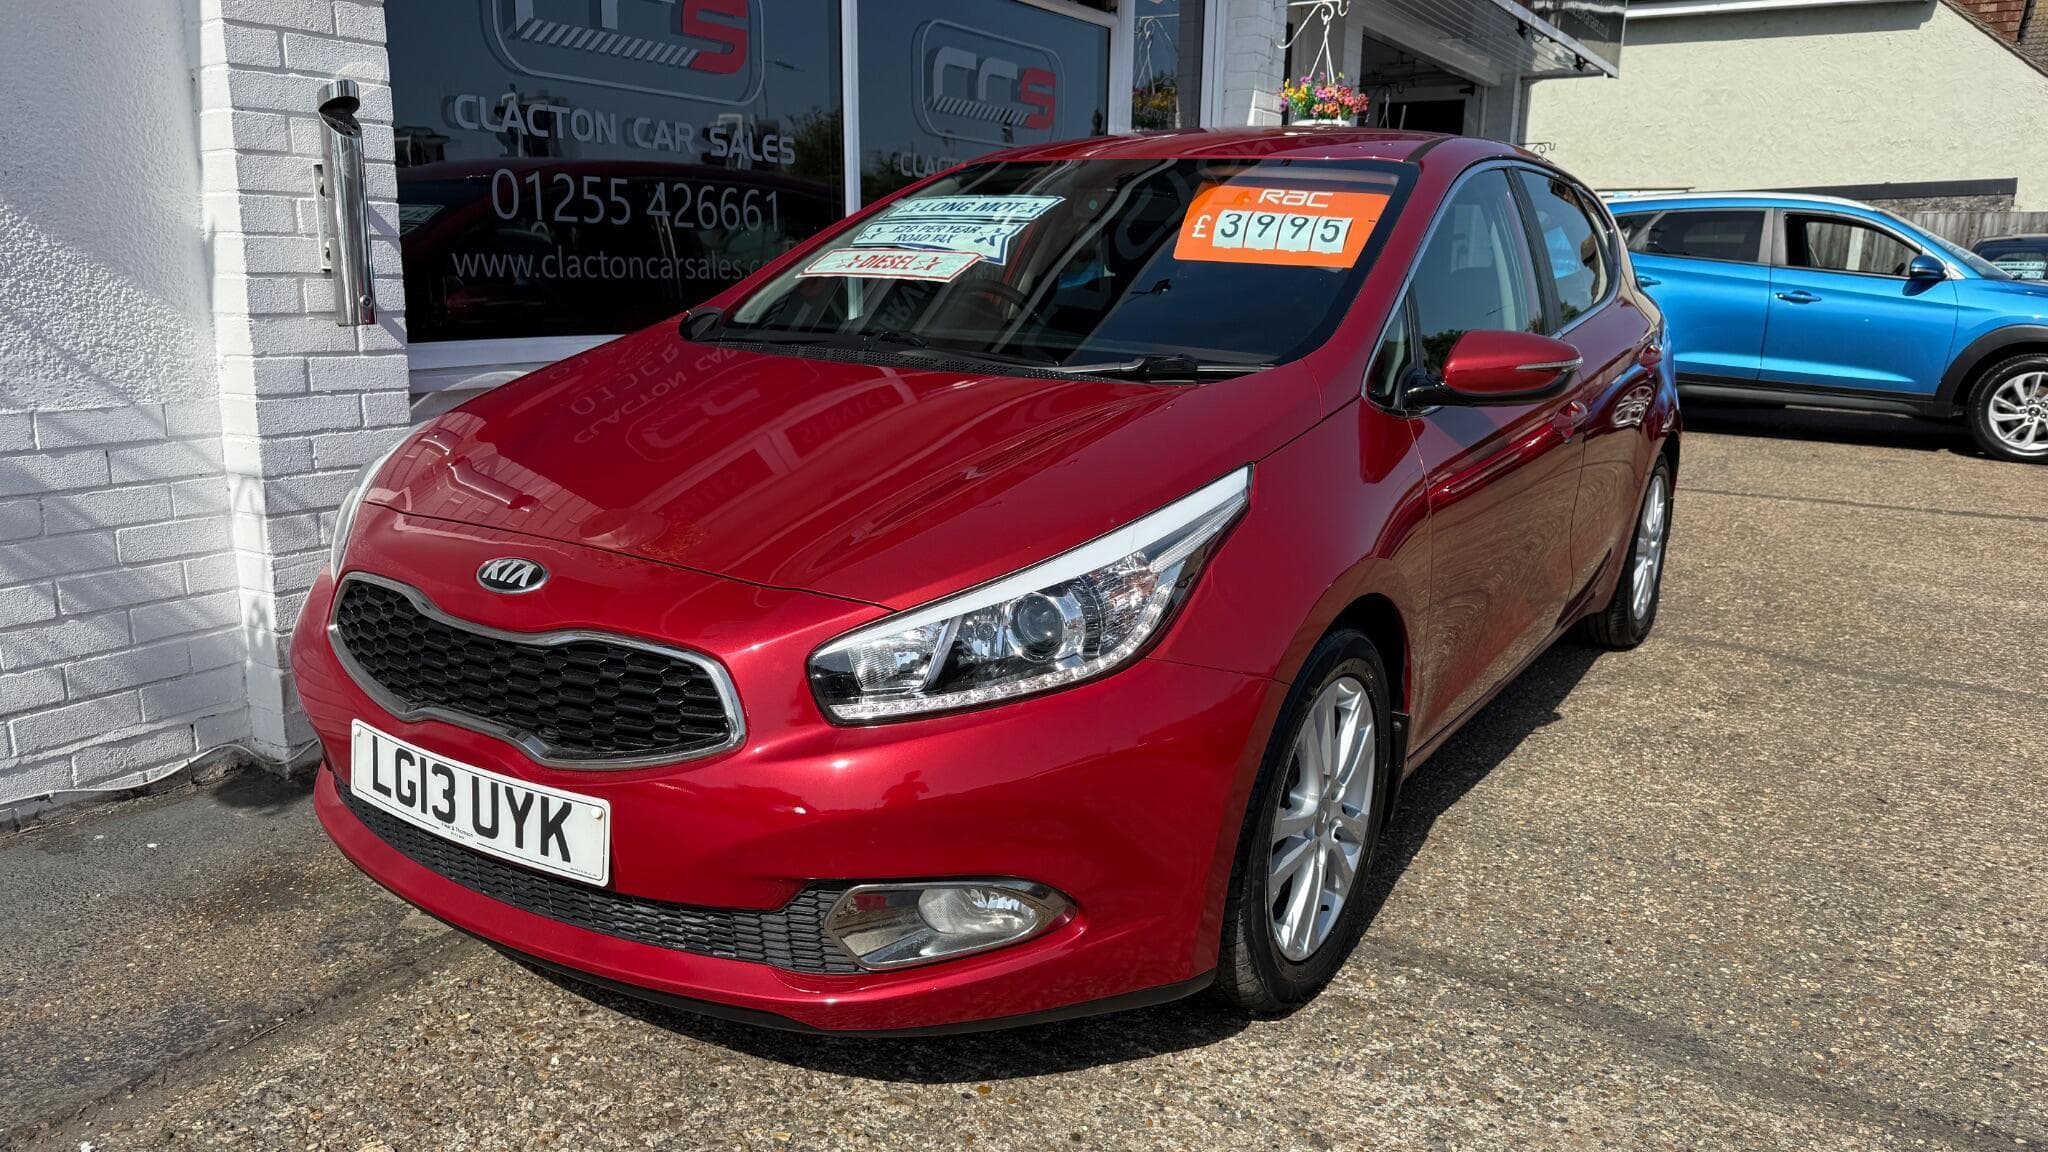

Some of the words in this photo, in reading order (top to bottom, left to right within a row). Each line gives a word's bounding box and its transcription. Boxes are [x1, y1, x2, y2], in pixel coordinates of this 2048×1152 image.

[932, 46, 1057, 130] CCS
[454, 94, 617, 144] CLACTON
[633, 117, 694, 152] CAR
[709, 127, 795, 165] SALES
[492, 168, 631, 225] 01255
[647, 182, 779, 233] 426661
[923, 202, 976, 212] LONG
[973, 202, 1025, 213] MOT
[892, 234, 929, 242] ROAD
[919, 225, 945, 234] PER
[945, 225, 982, 234] YEAR
[1220, 213, 1343, 243] 3995
[855, 255, 918, 270] DIESEL
[482, 559, 538, 588] KIA
[372, 735, 456, 824] LG13
[471, 775, 573, 863] UYK
